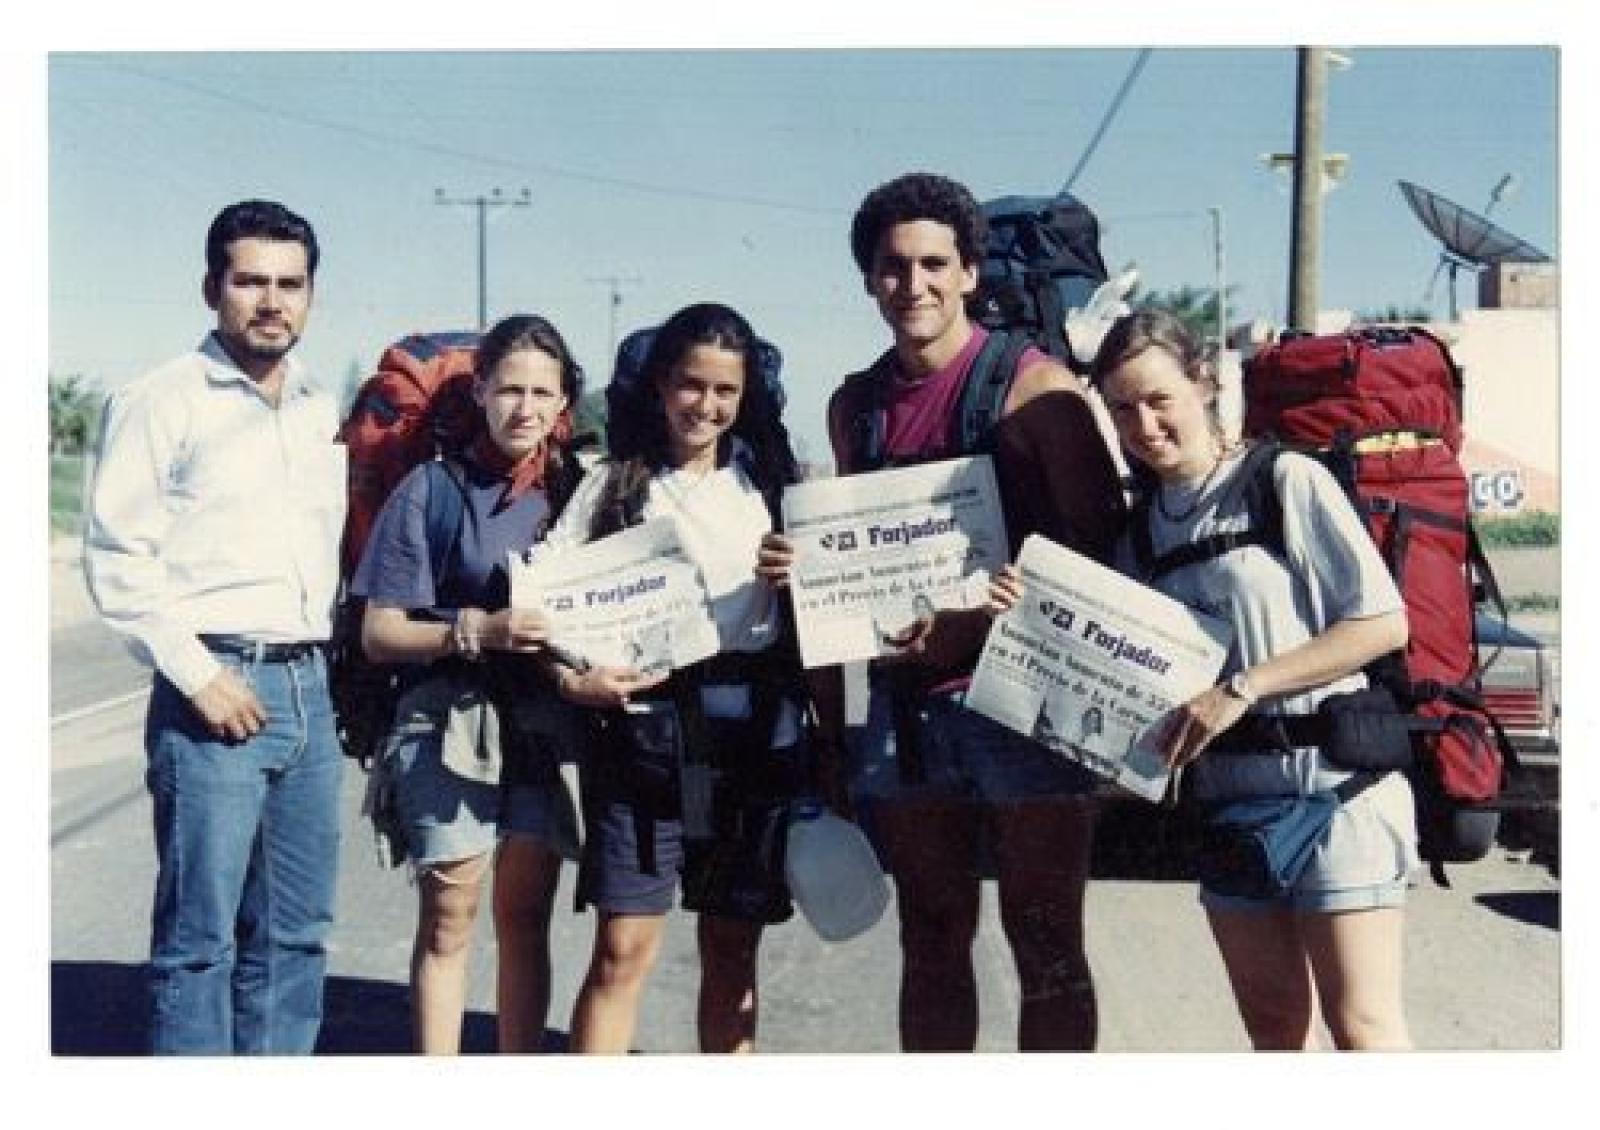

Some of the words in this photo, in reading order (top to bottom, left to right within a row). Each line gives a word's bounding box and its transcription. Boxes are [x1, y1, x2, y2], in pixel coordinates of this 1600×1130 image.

[868, 518, 957, 546] Forjador
[585, 575, 667, 606] Forjador
[1081, 620, 1172, 676] Forjador
